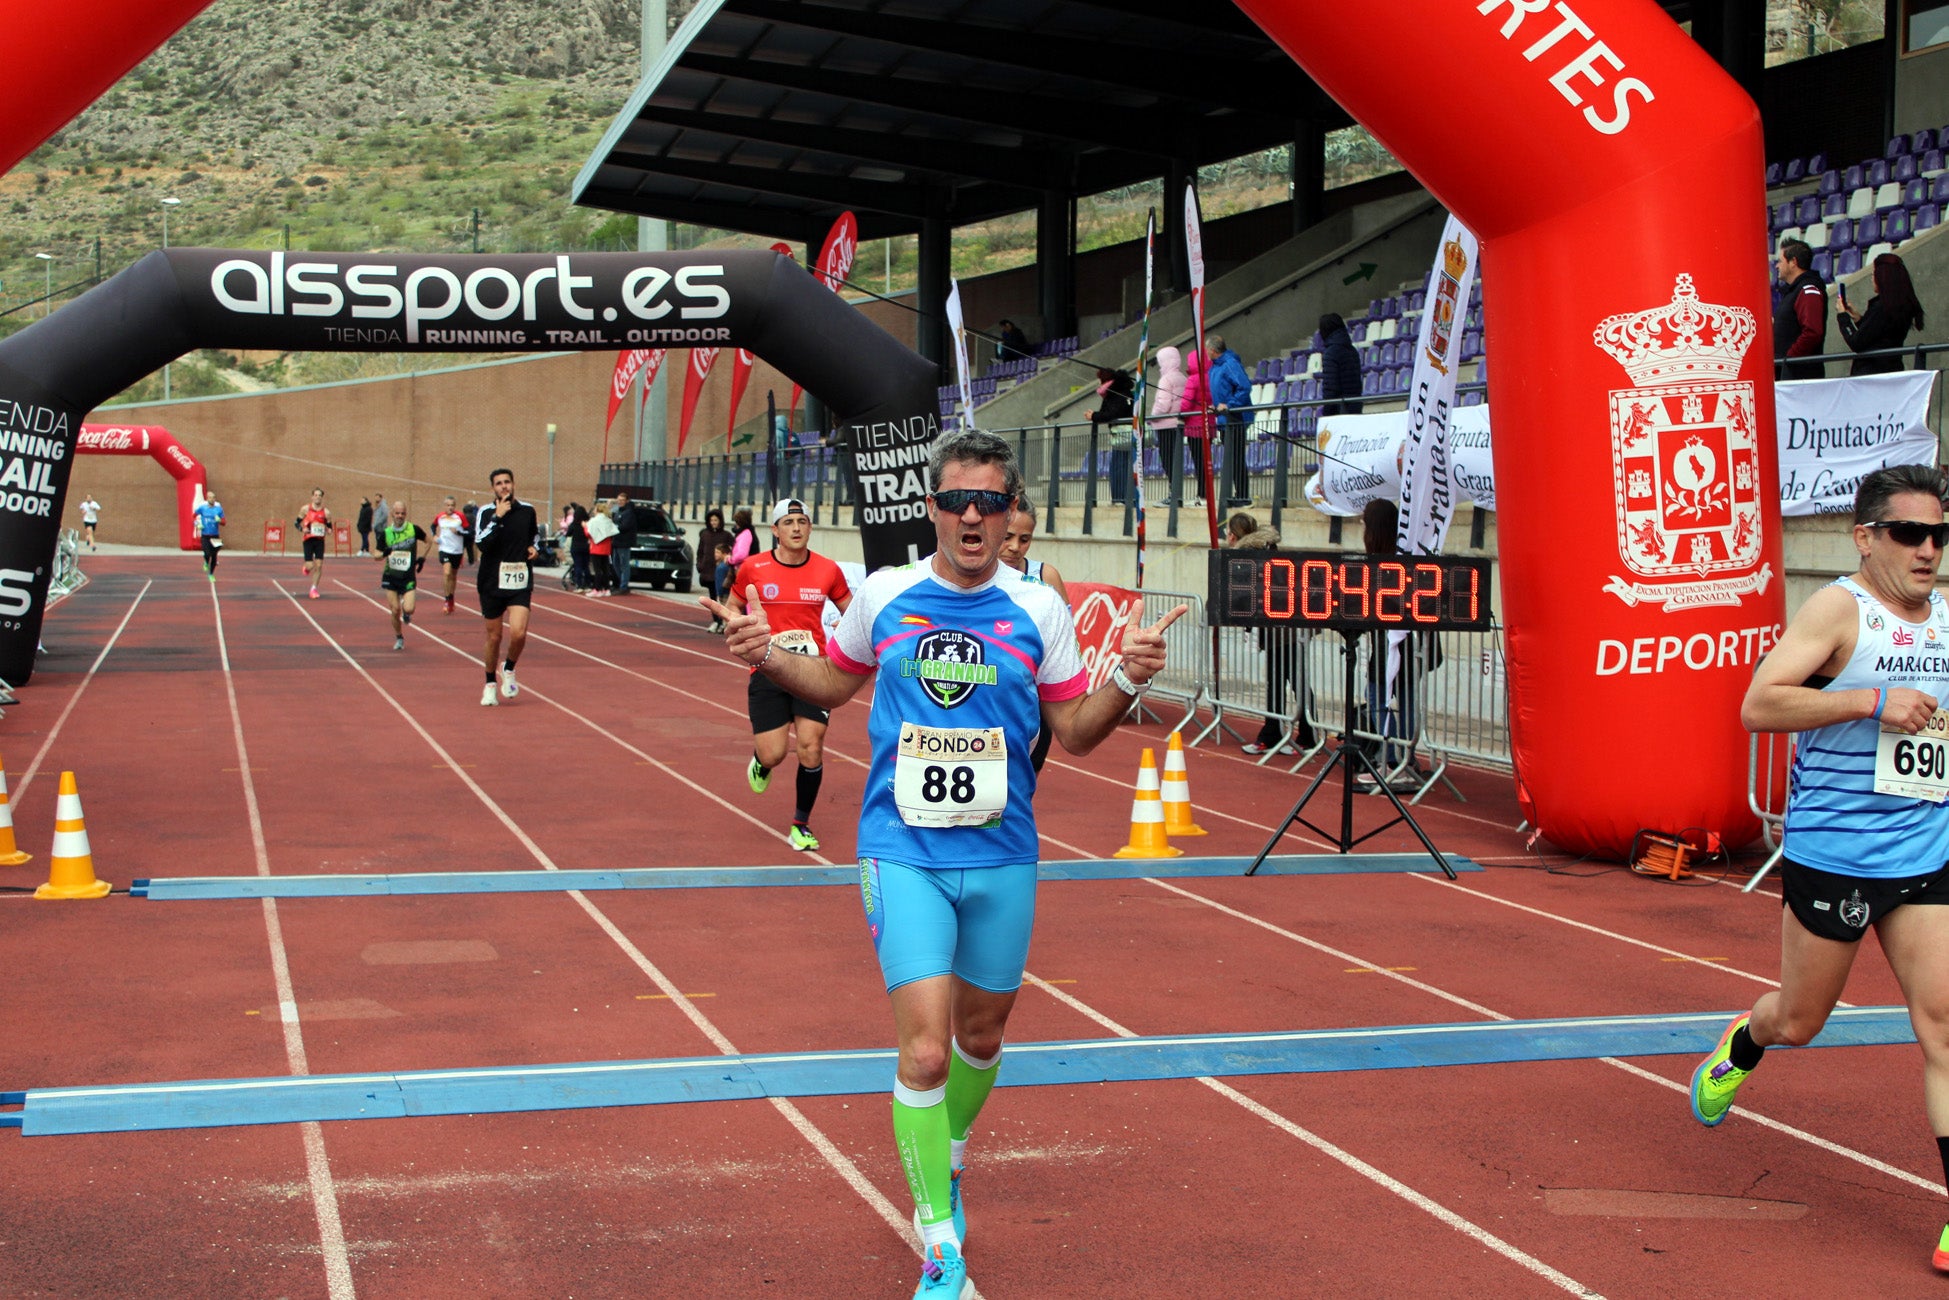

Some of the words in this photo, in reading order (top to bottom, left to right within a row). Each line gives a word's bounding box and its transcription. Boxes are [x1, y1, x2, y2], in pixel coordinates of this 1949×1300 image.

[1476, 0, 1655, 135] RTES
[211, 251, 731, 344] alssport.es
[324, 327, 401, 343] TIENDA
[426, 330, 526, 344] RUNNING
[546, 330, 608, 343] TRAIL
[627, 328, 731, 342] OUTDOOR
[0, 400, 69, 437] ENDA
[852, 412, 938, 448] TIENDA
[0, 430, 65, 460] NNING
[1333, 432, 1390, 460] Diputación
[1786, 413, 1904, 457] Diputación
[855, 442, 931, 471] RUNNIN
[0, 458, 56, 495] AIL
[858, 466, 931, 503] TRAI
[1454, 464, 1494, 491] Gran
[1781, 469, 1805, 500] de
[863, 501, 926, 524] OUTDO
[505, 573, 525, 583] 719
[1673, 592, 1731, 604] GRANADA
[781, 634, 804, 643] ONDO
[940, 632, 963, 643] CLUB
[1875, 656, 1949, 672] MARACEN
[920, 735, 986, 752] FONDO
[1894, 740, 1945, 779] 690
[922, 765, 975, 803] 88
